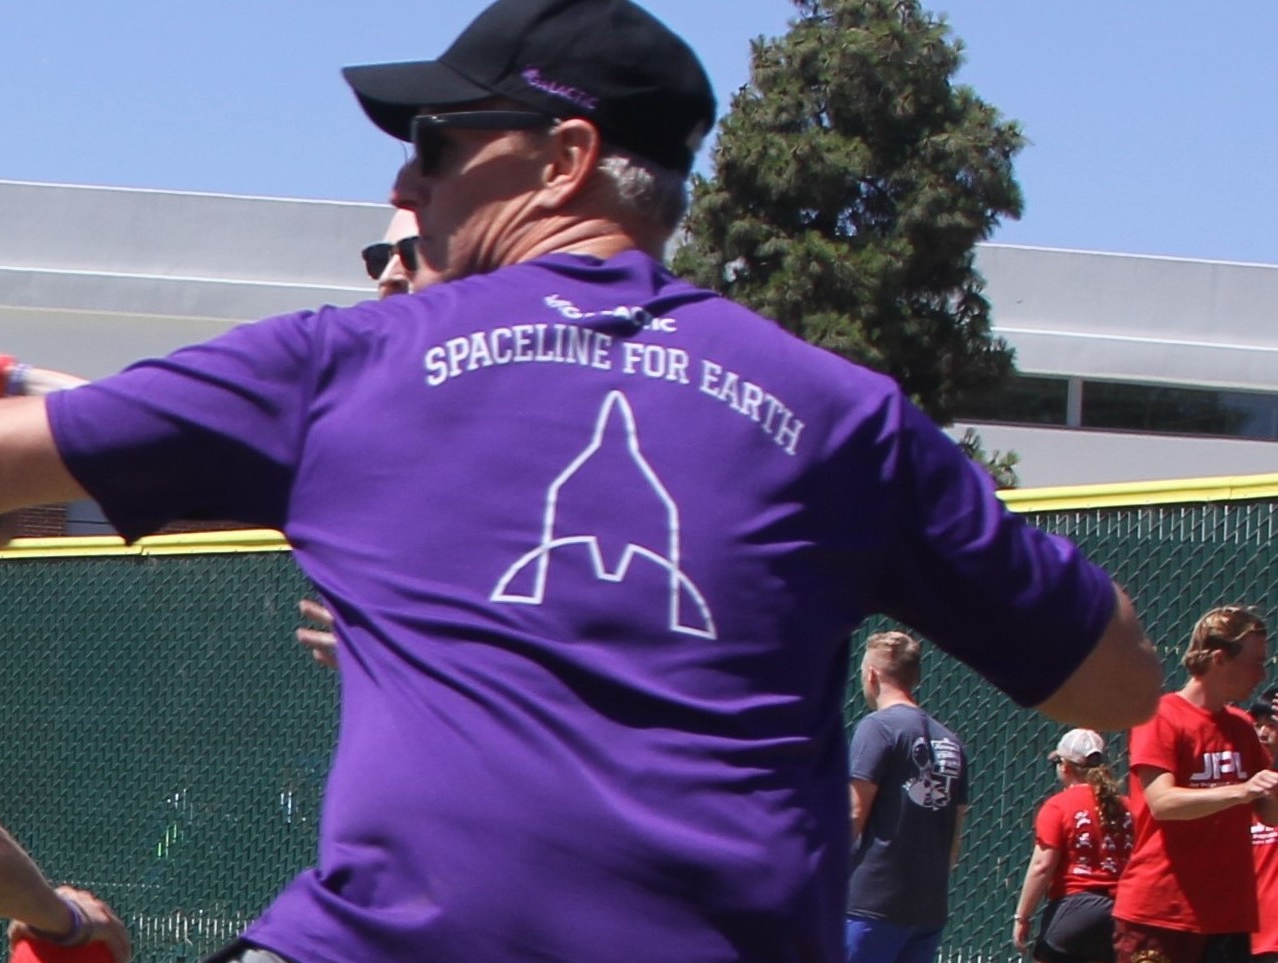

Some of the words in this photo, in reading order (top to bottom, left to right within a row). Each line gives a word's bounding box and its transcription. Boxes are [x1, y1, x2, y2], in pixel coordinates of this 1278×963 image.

[424, 322, 613, 387] SPACELINE
[622, 341, 691, 386] FOR
[698, 358, 806, 456] EARTH
[1189, 750, 1249, 780] JPL
